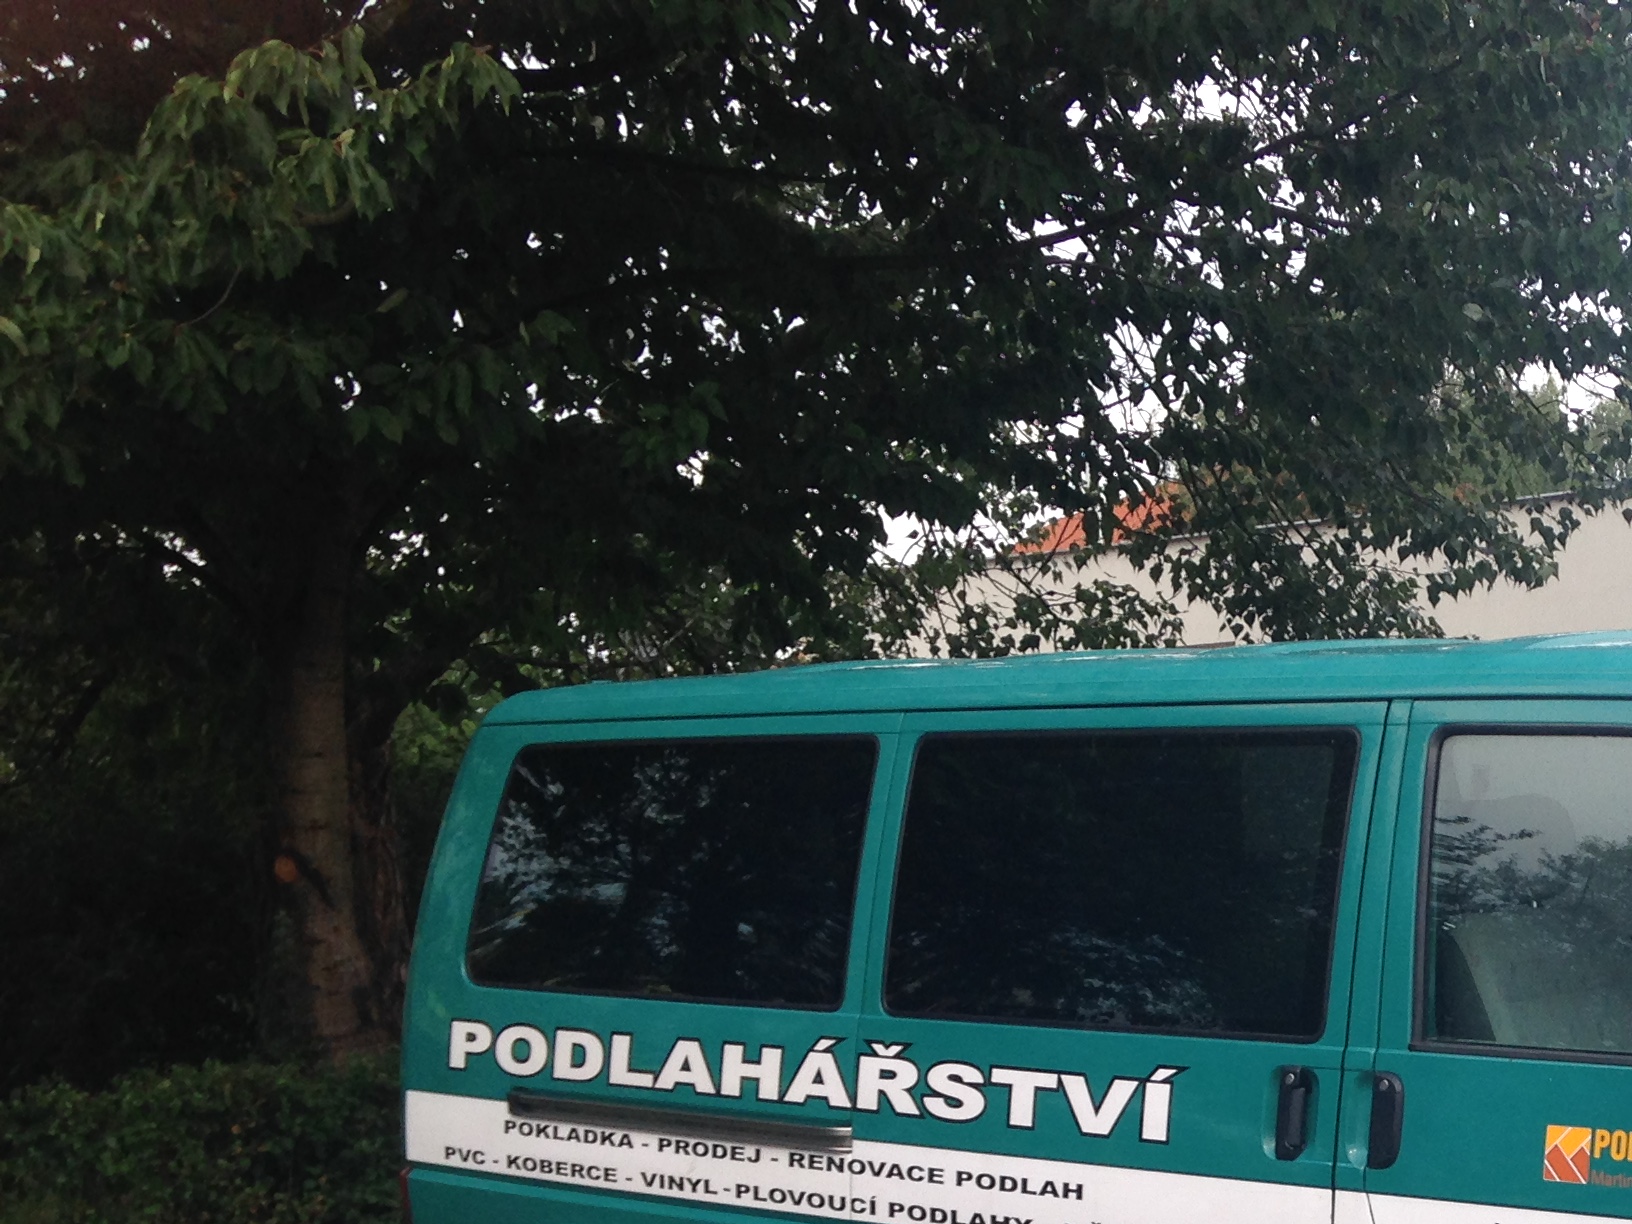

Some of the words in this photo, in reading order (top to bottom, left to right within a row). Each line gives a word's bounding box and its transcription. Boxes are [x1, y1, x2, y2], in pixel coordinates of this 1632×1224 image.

[447, 1019, 1190, 1145] PODLAHÁŘSTVÍ
[444, 1145, 487, 1166] PVC
[506, 1154, 618, 1183] KOBERCE
[641, 1171, 718, 1196] VINYL
[735, 1183, 878, 1216] PLOVOUCÍ
[504, 1119, 634, 1149] POKLADKA
[657, 1137, 761, 1163] PRODEJ
[788, 1151, 945, 1184] RENOVACE
[955, 1170, 1084, 1201] PODLAH
